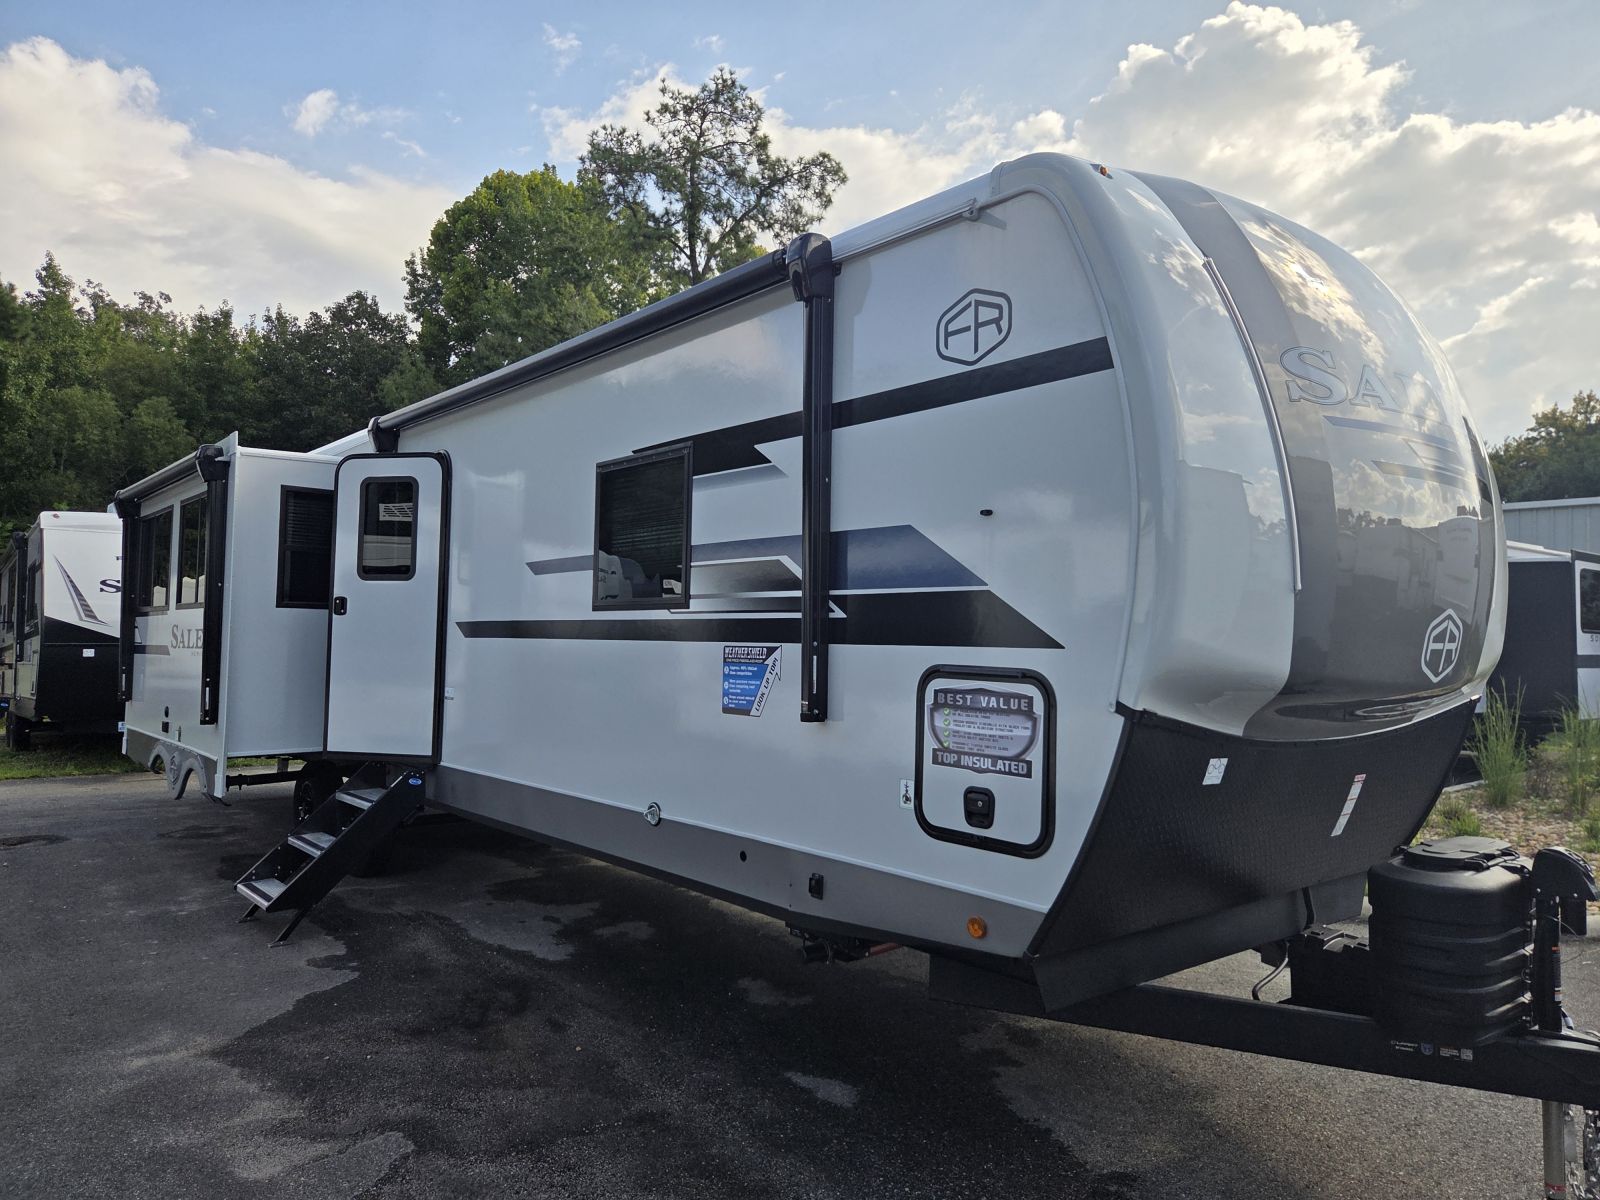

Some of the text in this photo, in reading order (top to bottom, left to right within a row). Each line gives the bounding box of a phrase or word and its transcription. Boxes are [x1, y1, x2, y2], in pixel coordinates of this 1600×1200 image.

[171, 624, 203, 649] SALE
[755, 691, 766, 712] LOOK
[763, 677, 770, 690] UP
[937, 692, 1029, 711] BEST VALUE
[936, 751, 1027, 775] TOP INSULATED
